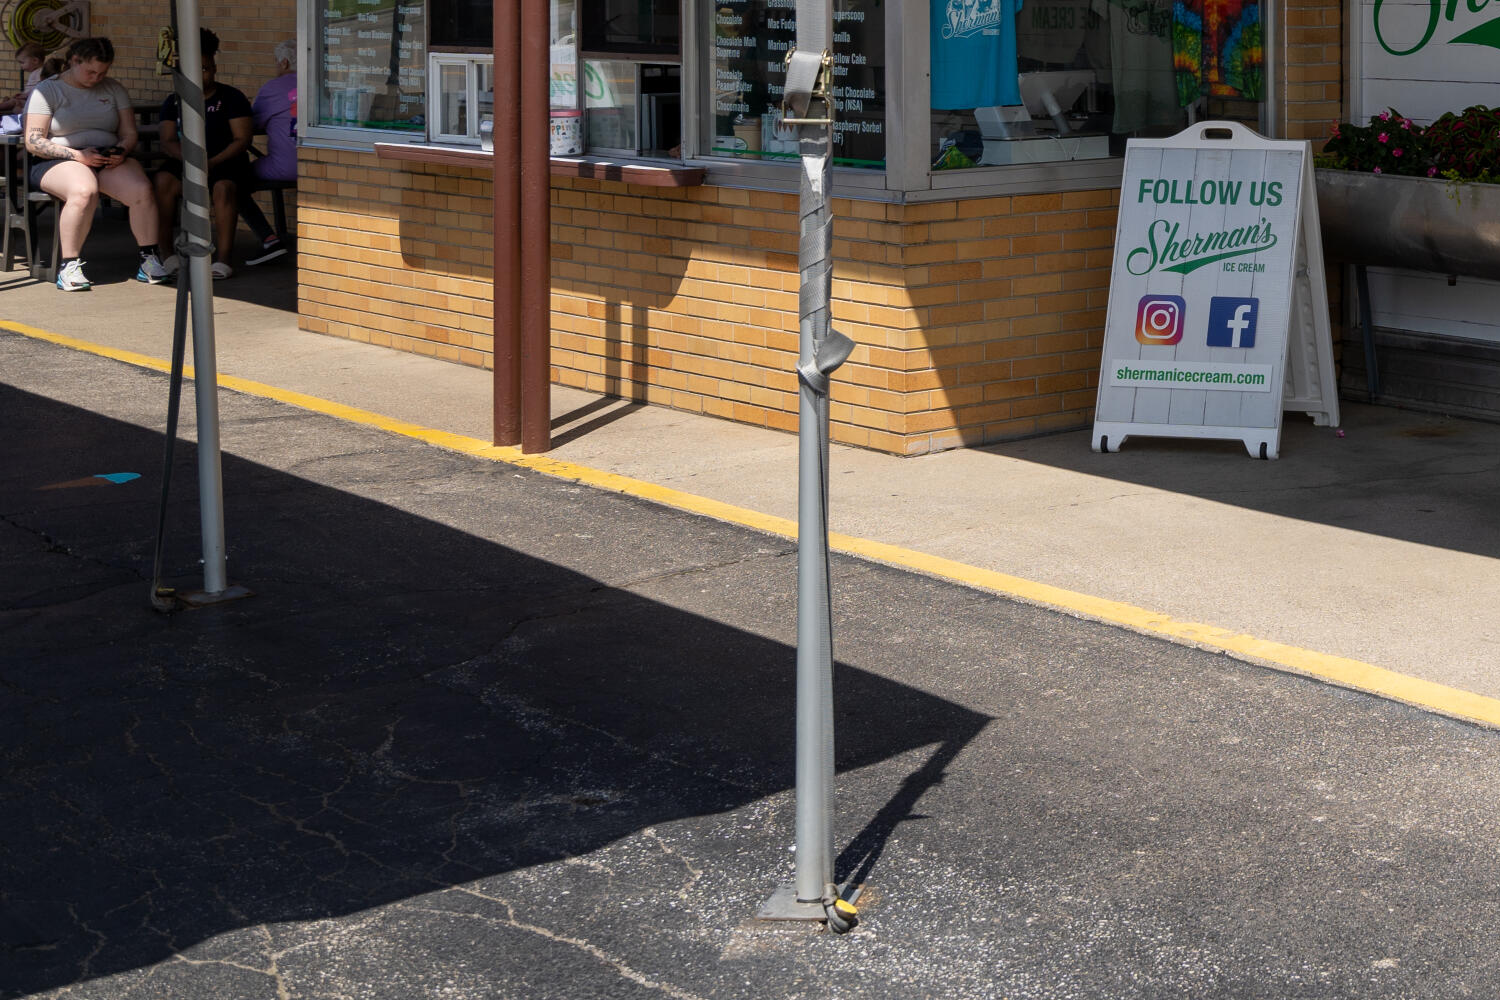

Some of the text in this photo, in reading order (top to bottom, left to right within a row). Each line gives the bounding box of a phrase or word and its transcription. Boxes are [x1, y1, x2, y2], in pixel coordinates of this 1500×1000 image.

[716, 14, 742, 25] Chocolate
[832, 11, 865, 23] uperscoop
[768, 18, 780, 29] Mac
[716, 36, 743, 47] Chocolate
[768, 40, 788, 51] Marion
[852, 53, 867, 64] Cake
[768, 62, 781, 73] Mint
[716, 68, 743, 80] Chocolate
[844, 86, 875, 99] Chocolate
[834, 100, 863, 113] hip (NSA)
[862, 122, 882, 134] Sorbet
[1137, 179, 1284, 207] FOLLOW US
[1126, 217, 1278, 276] Sherman's
[1222, 262, 1266, 274] ICE CREAM
[1116, 366, 1265, 386] shermanicecream.com
